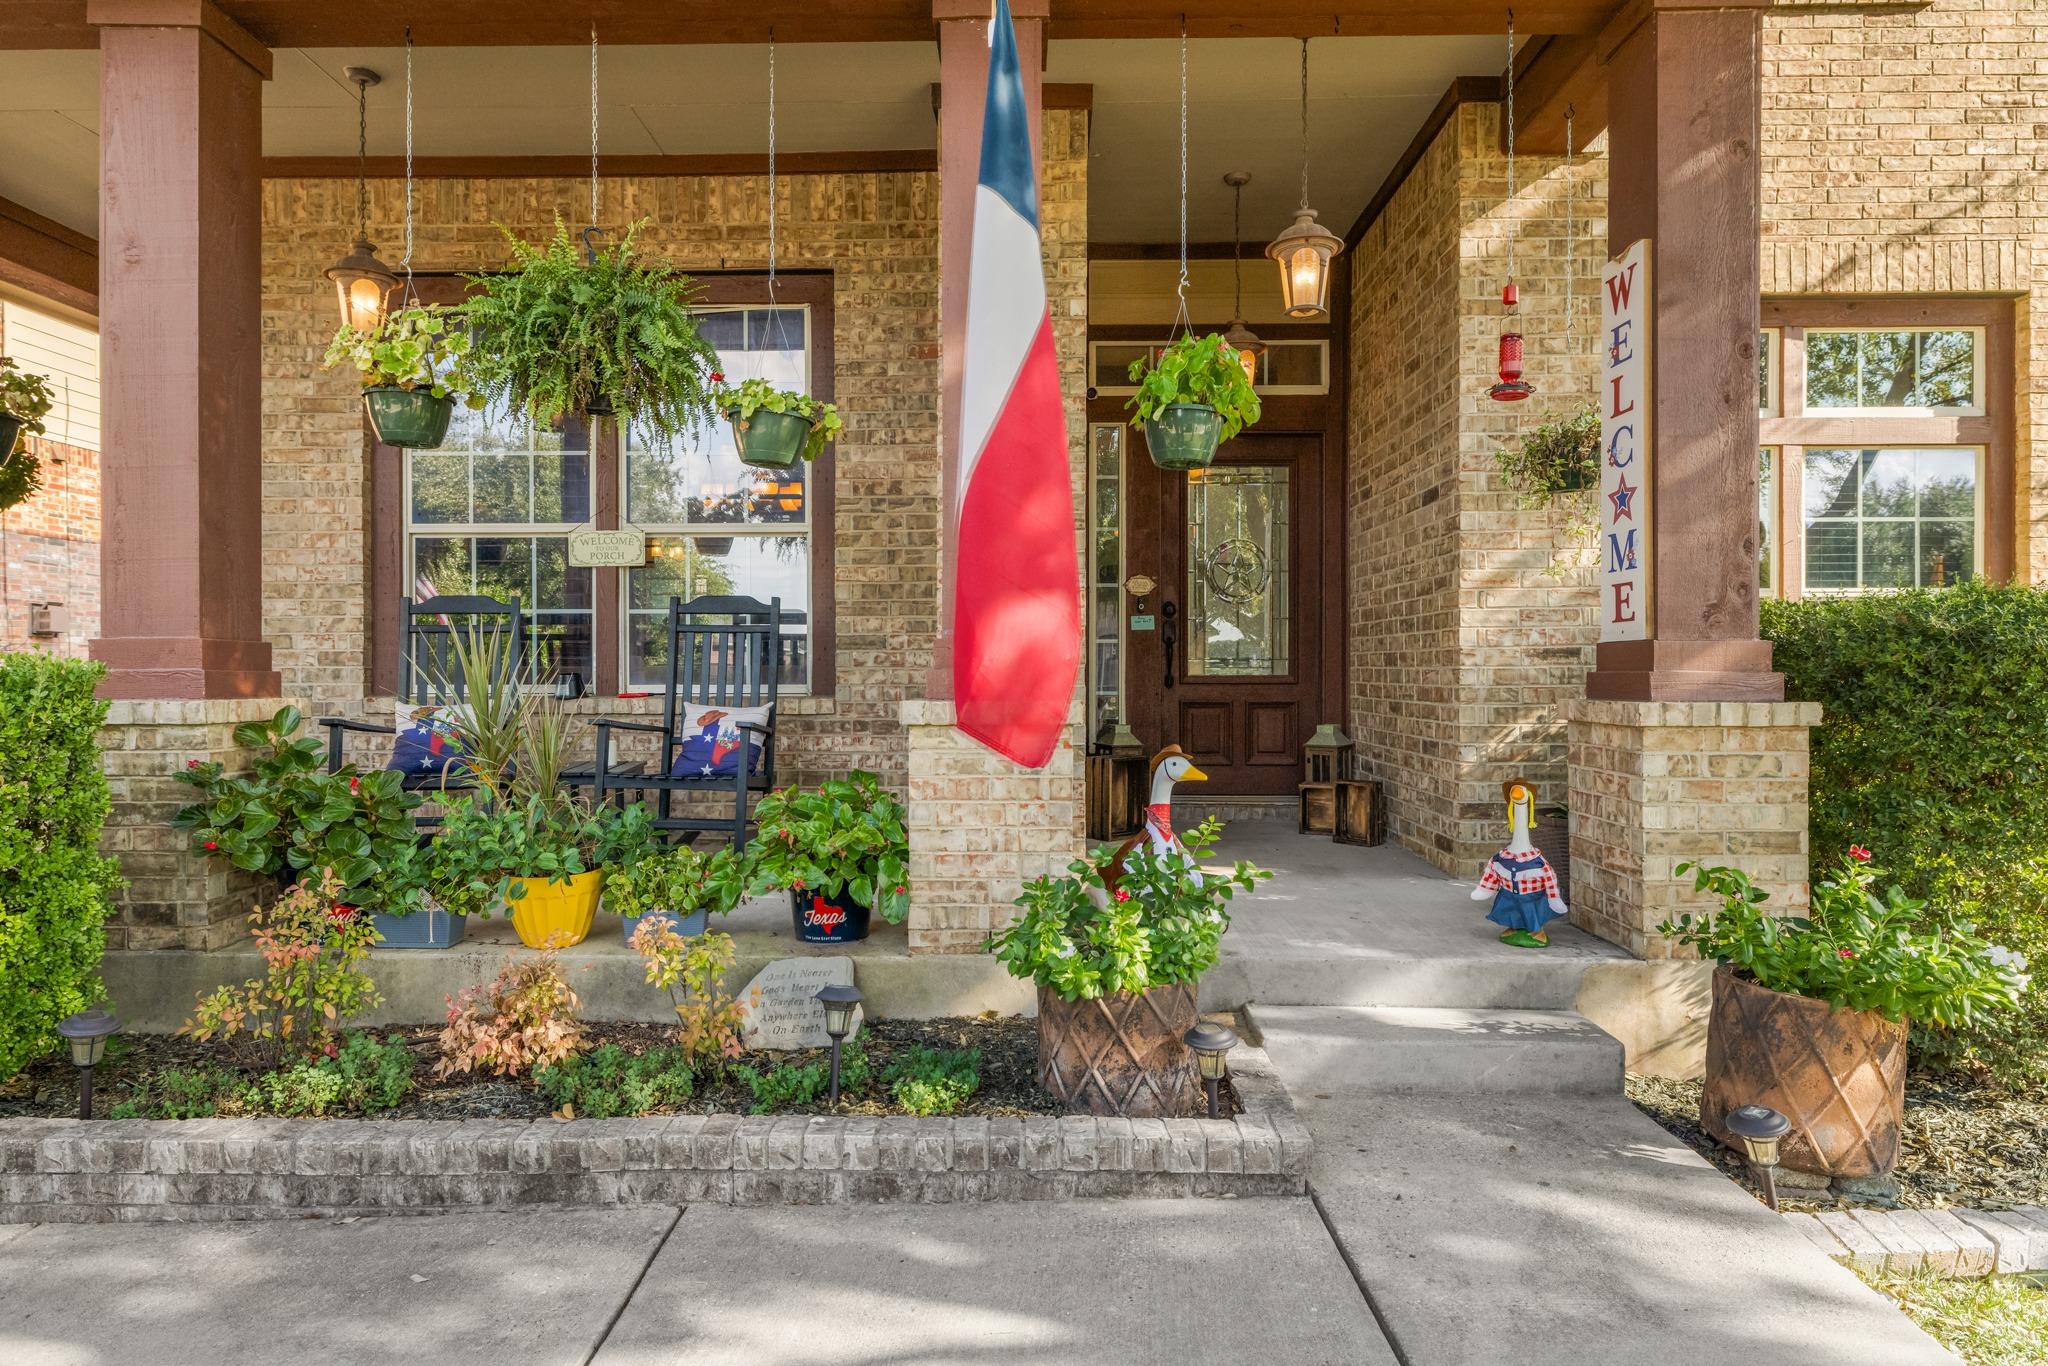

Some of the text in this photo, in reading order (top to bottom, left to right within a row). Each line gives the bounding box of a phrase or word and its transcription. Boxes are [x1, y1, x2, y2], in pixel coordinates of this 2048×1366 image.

[579, 537, 635, 546] WELCOME
[590, 552, 624, 560] PORCH
[804, 910, 847, 926] Texas
[800, 969, 833, 978] Nearer
[792, 984, 819, 992] Heart
[770, 997, 804, 1007] Garden
[760, 1012, 808, 1023] Anywhere
[772, 1024, 821, 1035] On Earth
